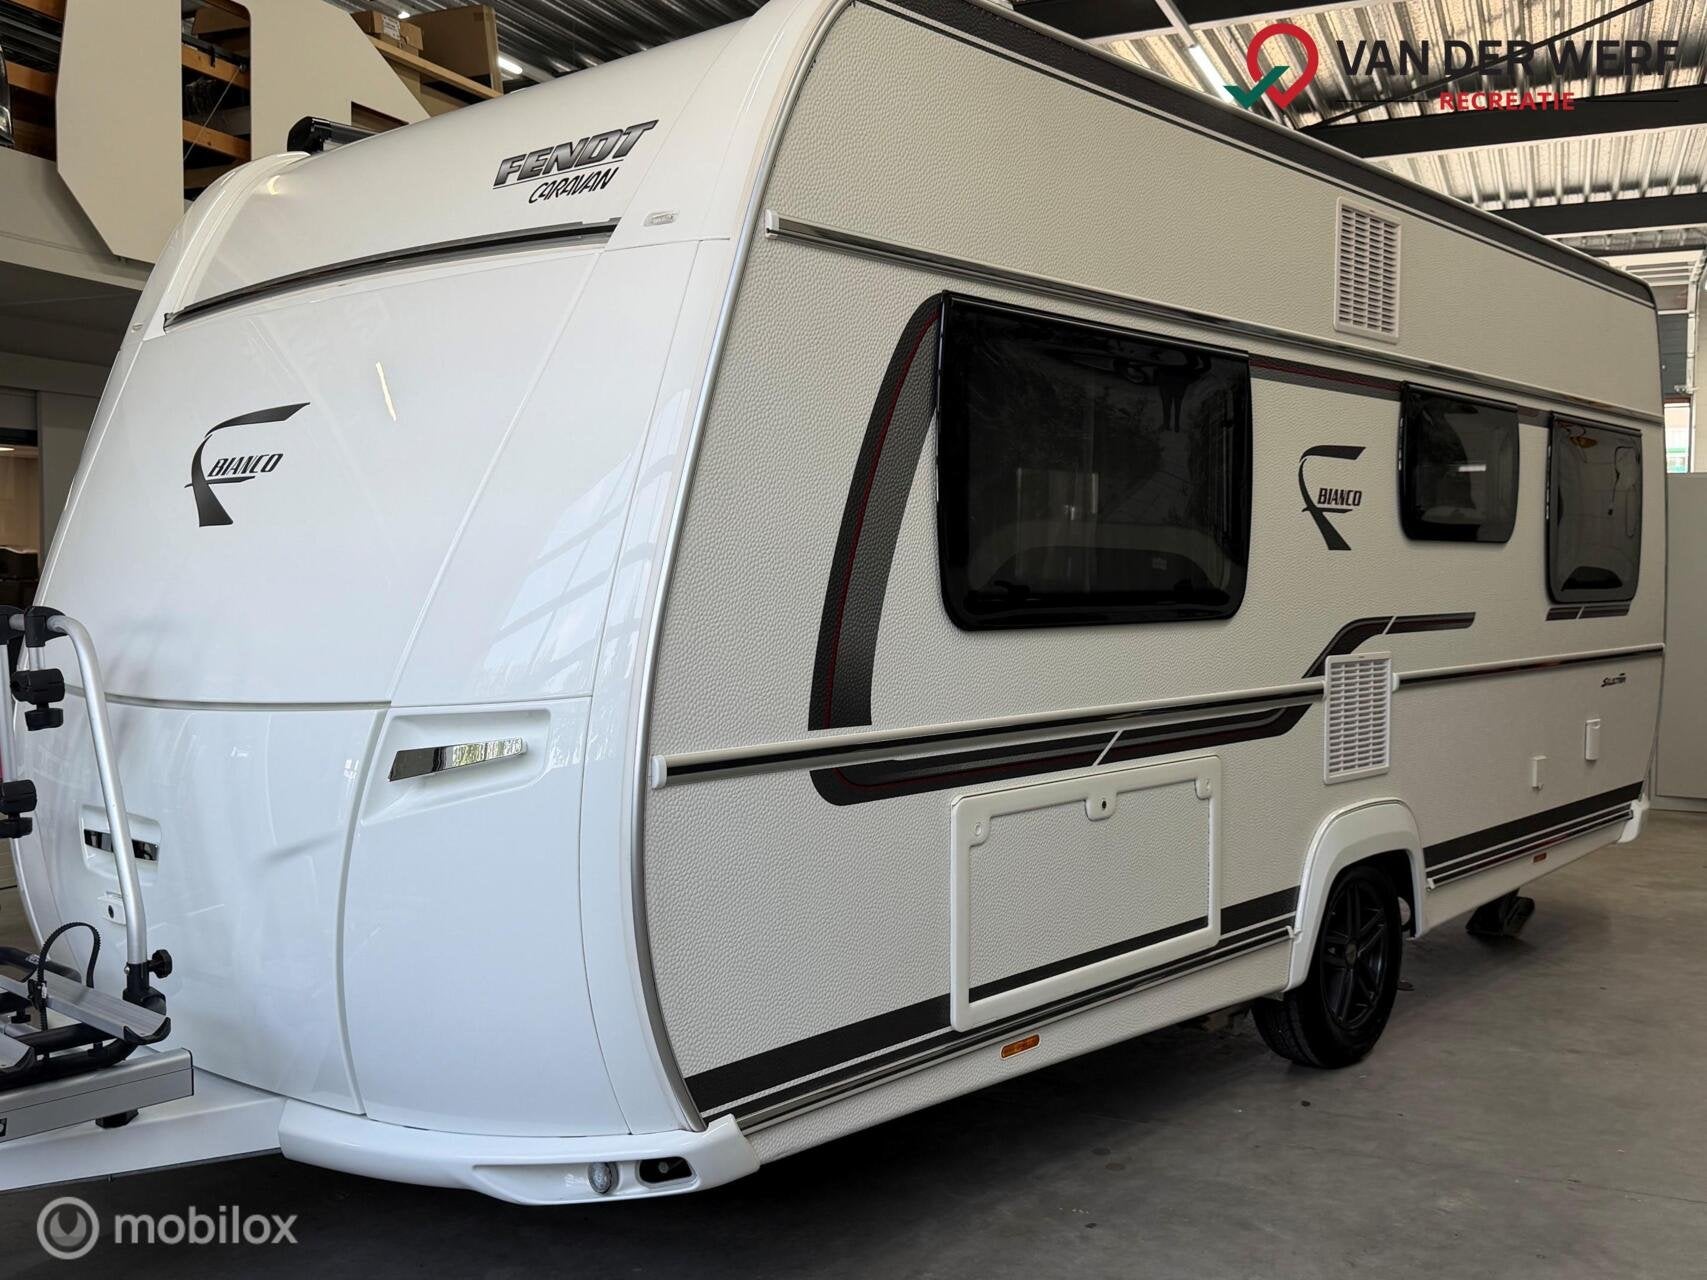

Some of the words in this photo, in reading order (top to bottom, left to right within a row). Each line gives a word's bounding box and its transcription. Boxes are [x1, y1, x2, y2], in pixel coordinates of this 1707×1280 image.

[493, 119, 659, 188] FENDT
[528, 166, 620, 204] CARAVAN
[207, 453, 284, 477] BIANCO
[1317, 487, 1363, 507] BIANCO
